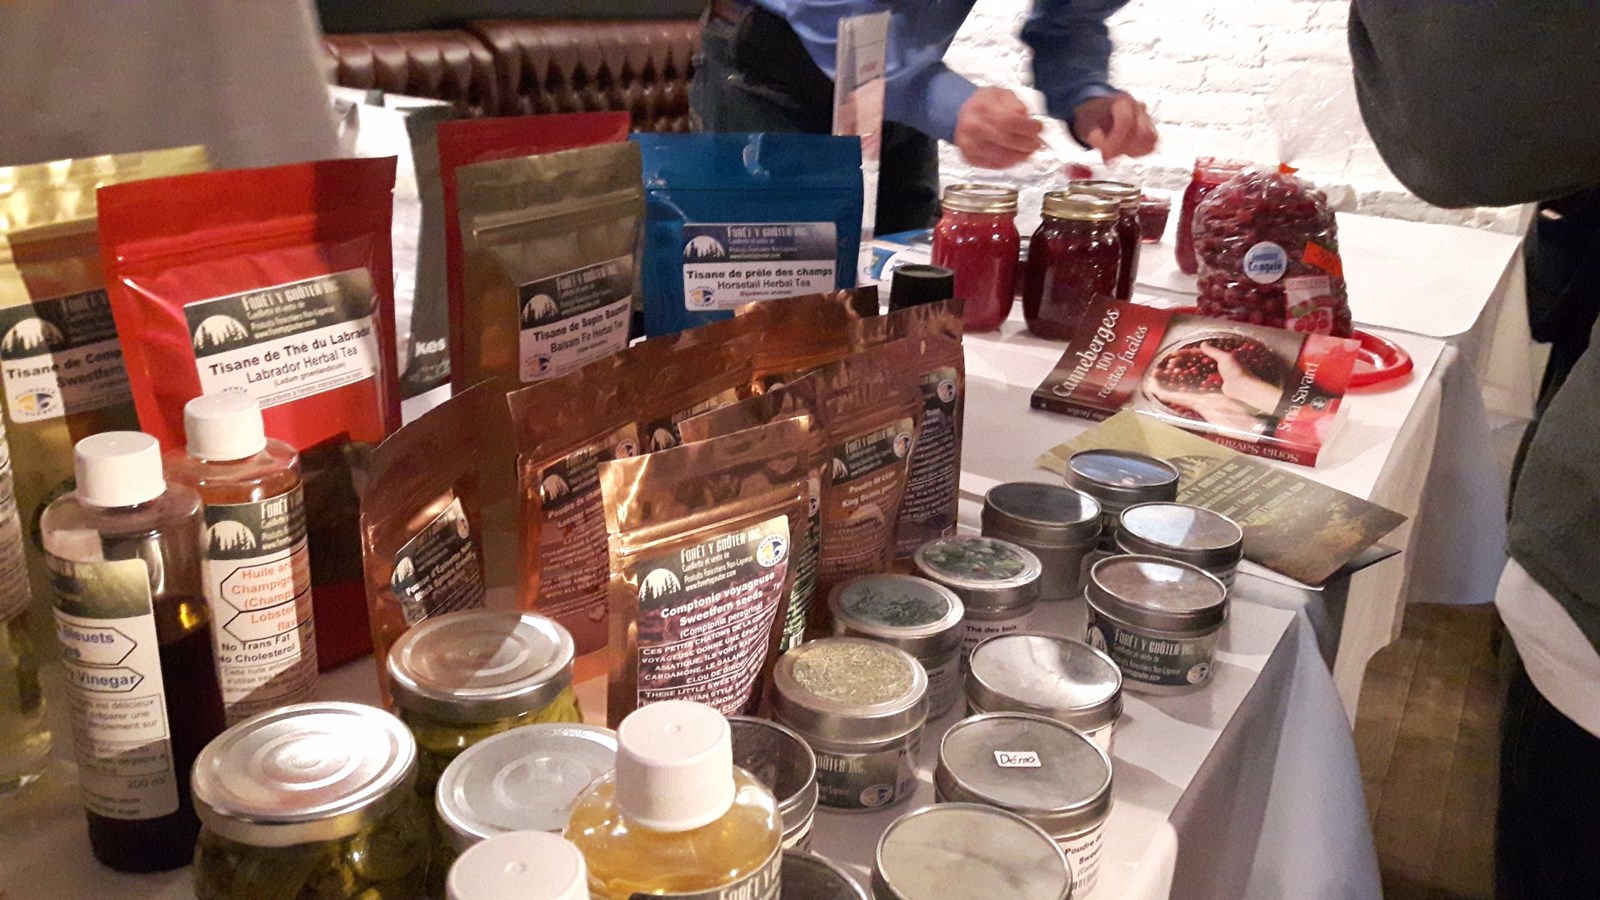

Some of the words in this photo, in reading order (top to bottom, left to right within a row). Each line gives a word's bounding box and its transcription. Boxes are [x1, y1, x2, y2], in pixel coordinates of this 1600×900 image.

[686, 269, 725, 280] Tisane
[729, 269, 742, 279] de
[745, 268, 772, 280] prêle
[775, 267, 793, 277] des
[796, 266, 834, 278] champs
[717, 279, 760, 290] Horsetail
[763, 278, 793, 289] Herbal
[795, 277, 811, 288] Tea
[241, 292, 274, 312] FORÊT
[276, 291, 284, 304] Y
[285, 283, 322, 302] GOÛTER
[532, 326, 567, 343] Tisane
[569, 321, 579, 332] de
[581, 313, 604, 330] Sapin
[550, 336, 581, 354] Balsam
[581, 331, 592, 343] Fir
[1052, 307, 1120, 398] Canneberges
[6, 362, 59, 380] Tisane
[64, 358, 82, 370] de
[85, 347, 121, 364] Comp
[208, 356, 264, 377] Tisane
[263, 350, 281, 364] de
[283, 341, 309, 358] Thé
[312, 337, 327, 351] du
[246, 361, 301, 384] Labrador
[303, 350, 338, 369] Herbal
[342, 346, 358, 361] Tea
[1095, 351, 1116, 372] 100
[1097, 366, 1127, 400] recettes
[1116, 324, 1148, 368] faciles
[57, 365, 122, 389] Sweetfern
[1291, 361, 1320, 404] Savard
[1263, 447, 1300, 464] Sonia
[261, 497, 289, 519] FORÊT
[841, 496, 859, 509] King
[680, 543, 705, 564] FORÊT
[708, 543, 715, 555] Y
[716, 532, 746, 552] GOÛTER
[710, 553, 724, 565] vente
[723, 551, 730, 560] de
[242, 566, 274, 581] Huile
[684, 569, 704, 584] Produits
[703, 564, 727, 580] Forestiers
[660, 592, 721, 620] Comptonie
[723, 571, 776, 599] voyageuse
[250, 604, 296, 624] Lobster
[679, 601, 734, 627] Sweetfern
[735, 589, 763, 607] seeds
[277, 618, 297, 632] flav
[680, 618, 727, 640] (Comptonia
[727, 601, 763, 624] peregrina)
[966, 625, 983, 633] Thé
[984, 625, 1000, 633] des
[1001, 624, 1017, 632] bois
[221, 642, 237, 652] No
[242, 639, 273, 651] Trans
[275, 633, 291, 646] Fat
[643, 647, 663, 656] CES
[694, 628, 731, 646] CHATONS
[731, 624, 742, 633] DE
[742, 619, 752, 628] LA
[1114, 627, 1138, 649] FORÊT
[1141, 639, 1146, 651] Y
[1148, 640, 1179, 656] GOÛTER
[235, 643, 295, 663] Cholesterol
[641, 649, 695, 664] VOYAGEUSE
[696, 639, 725, 654] DONNE
[725, 632, 741, 645] UNE
[654, 655, 704, 671] ASIATIQUE,
[718, 643, 738, 657] VONT
[686, 673, 710, 685] CLOU
[710, 668, 722, 679] DE
[705, 662, 716, 671] LE
[79, 670, 137, 689] Vinegar
[645, 690, 675, 699] THESE
[677, 683, 706, 695] LITTLE
[682, 692, 710, 702] ASIAN
[710, 686, 733, 699] STYLE
[112, 699, 154, 709] délicieux
[131, 711, 150, 719] une
[143, 720, 158, 728] sur
[1000, 753, 1036, 765] Démo
[127, 779, 149, 789] 200
[1064, 840, 1095, 855] Poudre
